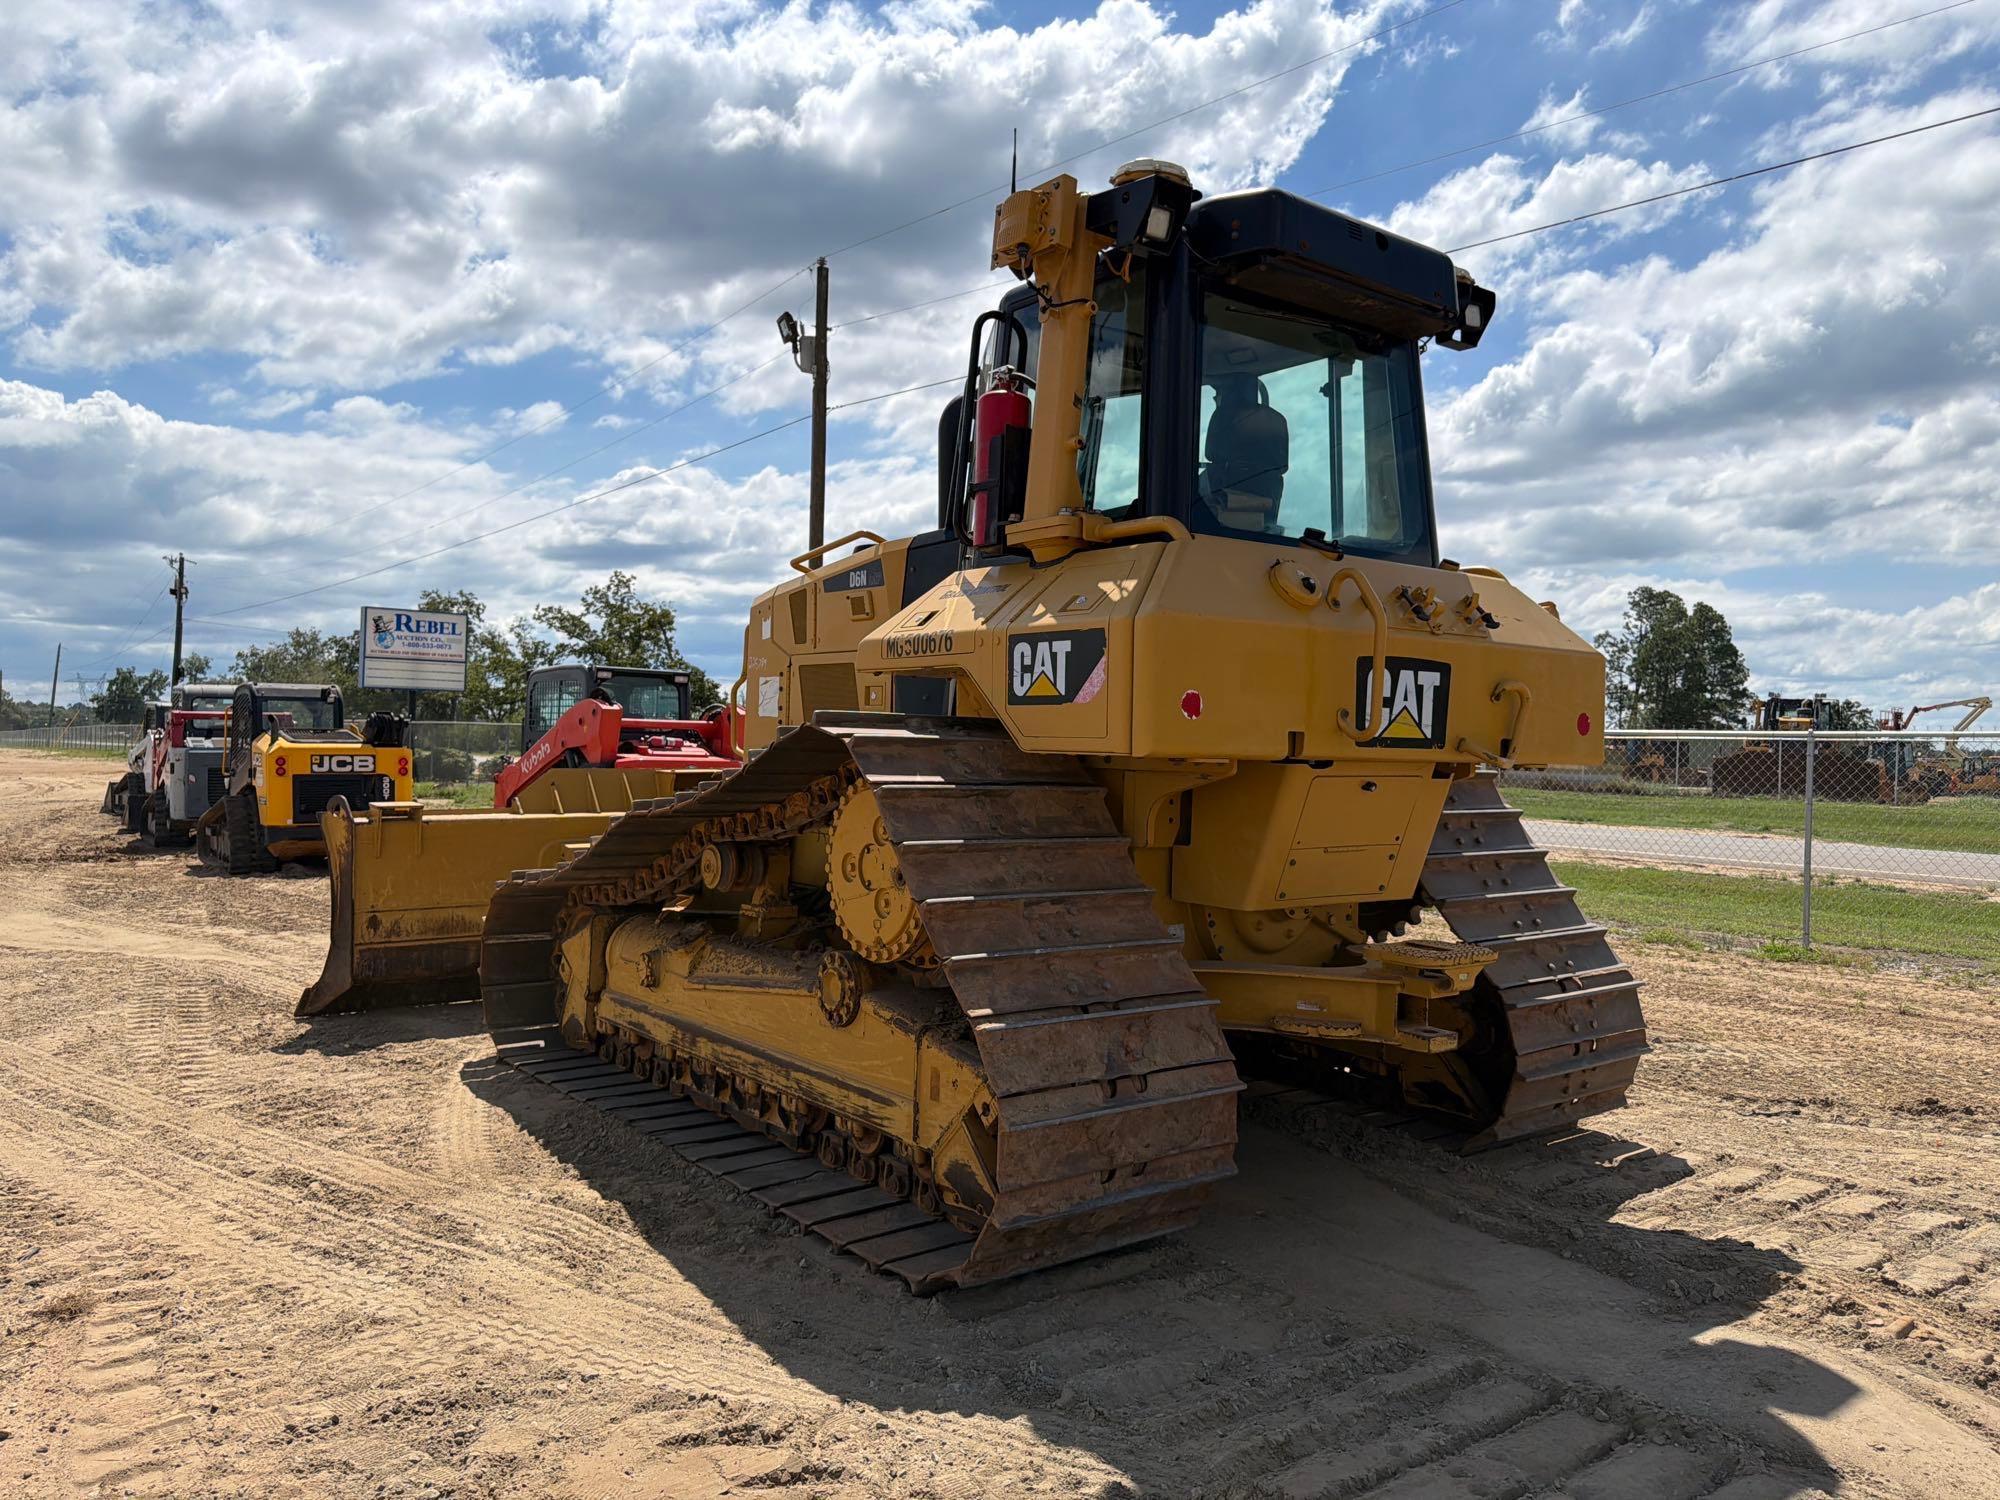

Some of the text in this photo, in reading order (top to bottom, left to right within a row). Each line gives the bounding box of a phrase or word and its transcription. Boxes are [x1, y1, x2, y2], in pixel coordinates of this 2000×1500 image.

[849, 570, 867, 588] D6N
[395, 613, 462, 635] REBEL
[1013, 639, 1072, 697] CAT
[311, 755, 375, 773] JCB
[521, 743, 550, 773] Kubota
